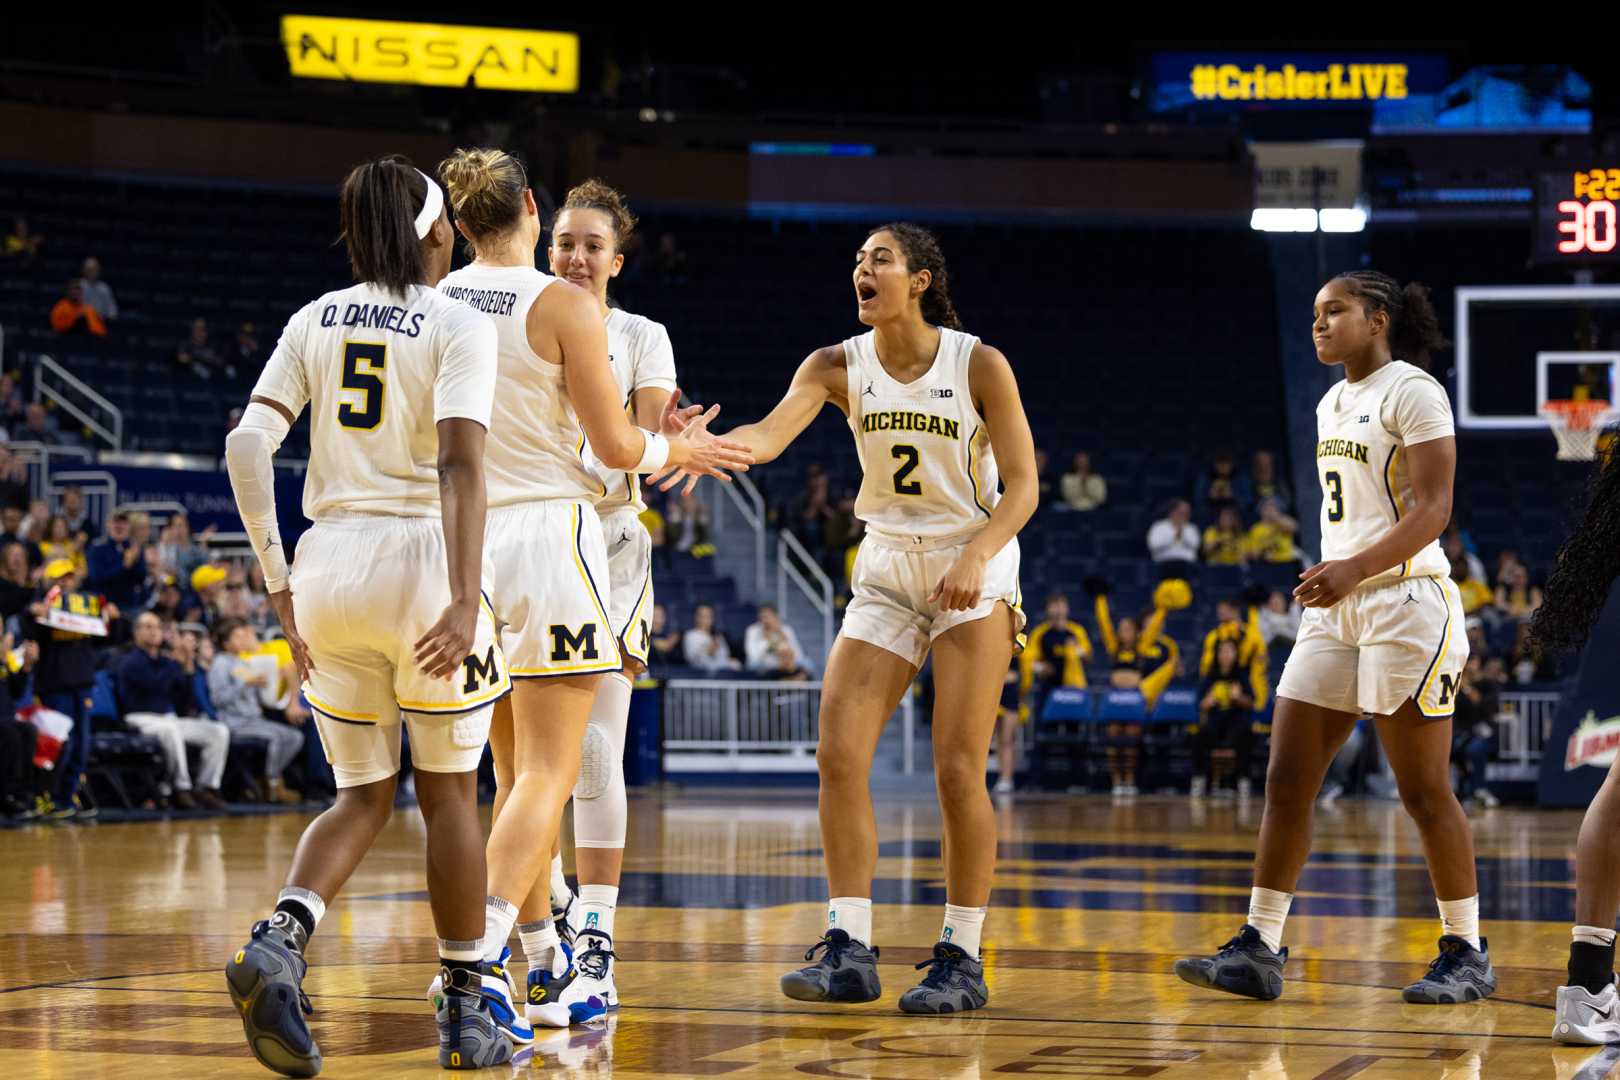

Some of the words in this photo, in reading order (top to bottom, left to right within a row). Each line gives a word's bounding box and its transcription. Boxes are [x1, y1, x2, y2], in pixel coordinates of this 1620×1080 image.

[299, 33, 560, 77] NISSAN
[1190, 64, 1409, 99] #CrislerLIVE
[1557, 200, 1617, 253] 30
[321, 304, 337, 328] Q.
[342, 303, 425, 338] DANIELS
[337, 341, 387, 430] 5
[891, 444, 922, 495] 2
[1318, 439, 1369, 464] CHIGAN
[1325, 470, 1343, 522] 3
[550, 624, 599, 661] M
[463, 645, 499, 694] M
